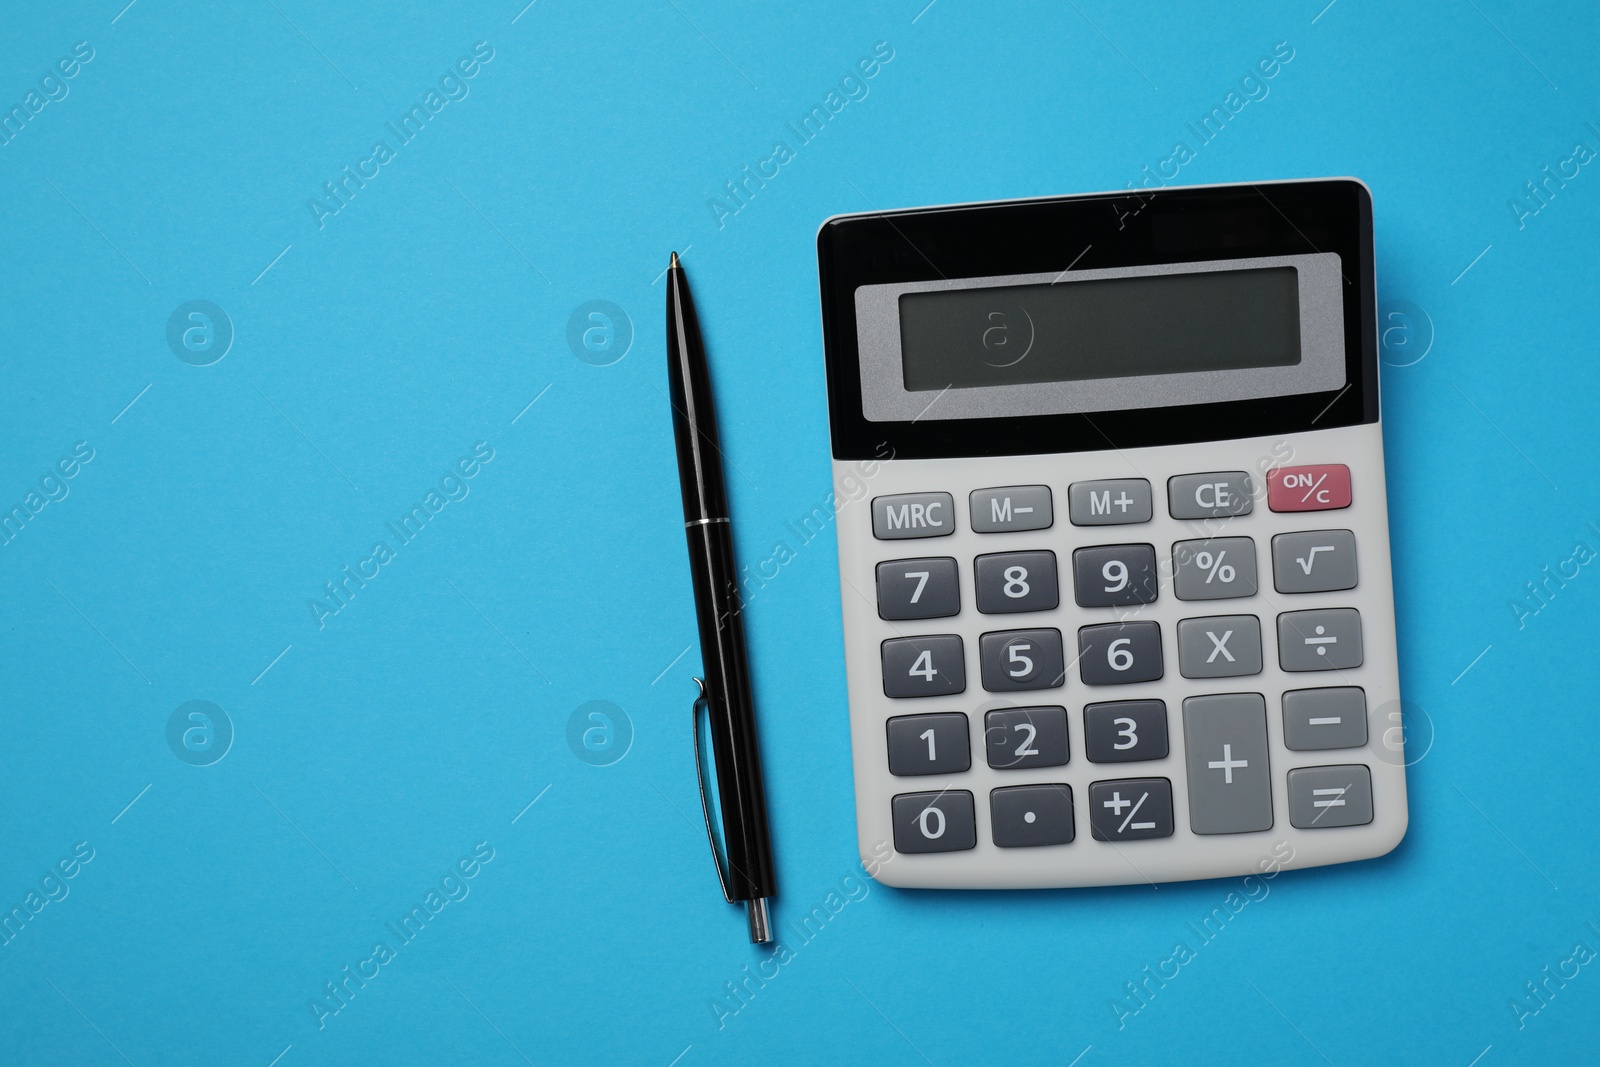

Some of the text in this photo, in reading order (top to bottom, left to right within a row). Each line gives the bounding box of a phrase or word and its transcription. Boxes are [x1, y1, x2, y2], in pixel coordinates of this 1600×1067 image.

[1090, 490, 1134, 516] M+
[1195, 482, 1230, 508] CE
[886, 504, 943, 530] MRC
[1003, 565, 1030, 598] 8
[1102, 560, 1129, 593] 9
[1196, 550, 1236, 584] %
[904, 571, 930, 604] 7
[908, 650, 938, 682] 4
[1008, 644, 1034, 677] 5
[1107, 638, 1134, 671] 6
[919, 728, 936, 761] 1
[1014, 723, 1039, 756] 2
[1113, 717, 1138, 750] 3
[1208, 744, 1248, 784] +
[1312, 787, 1346, 808] =
[919, 806, 946, 839] 0
